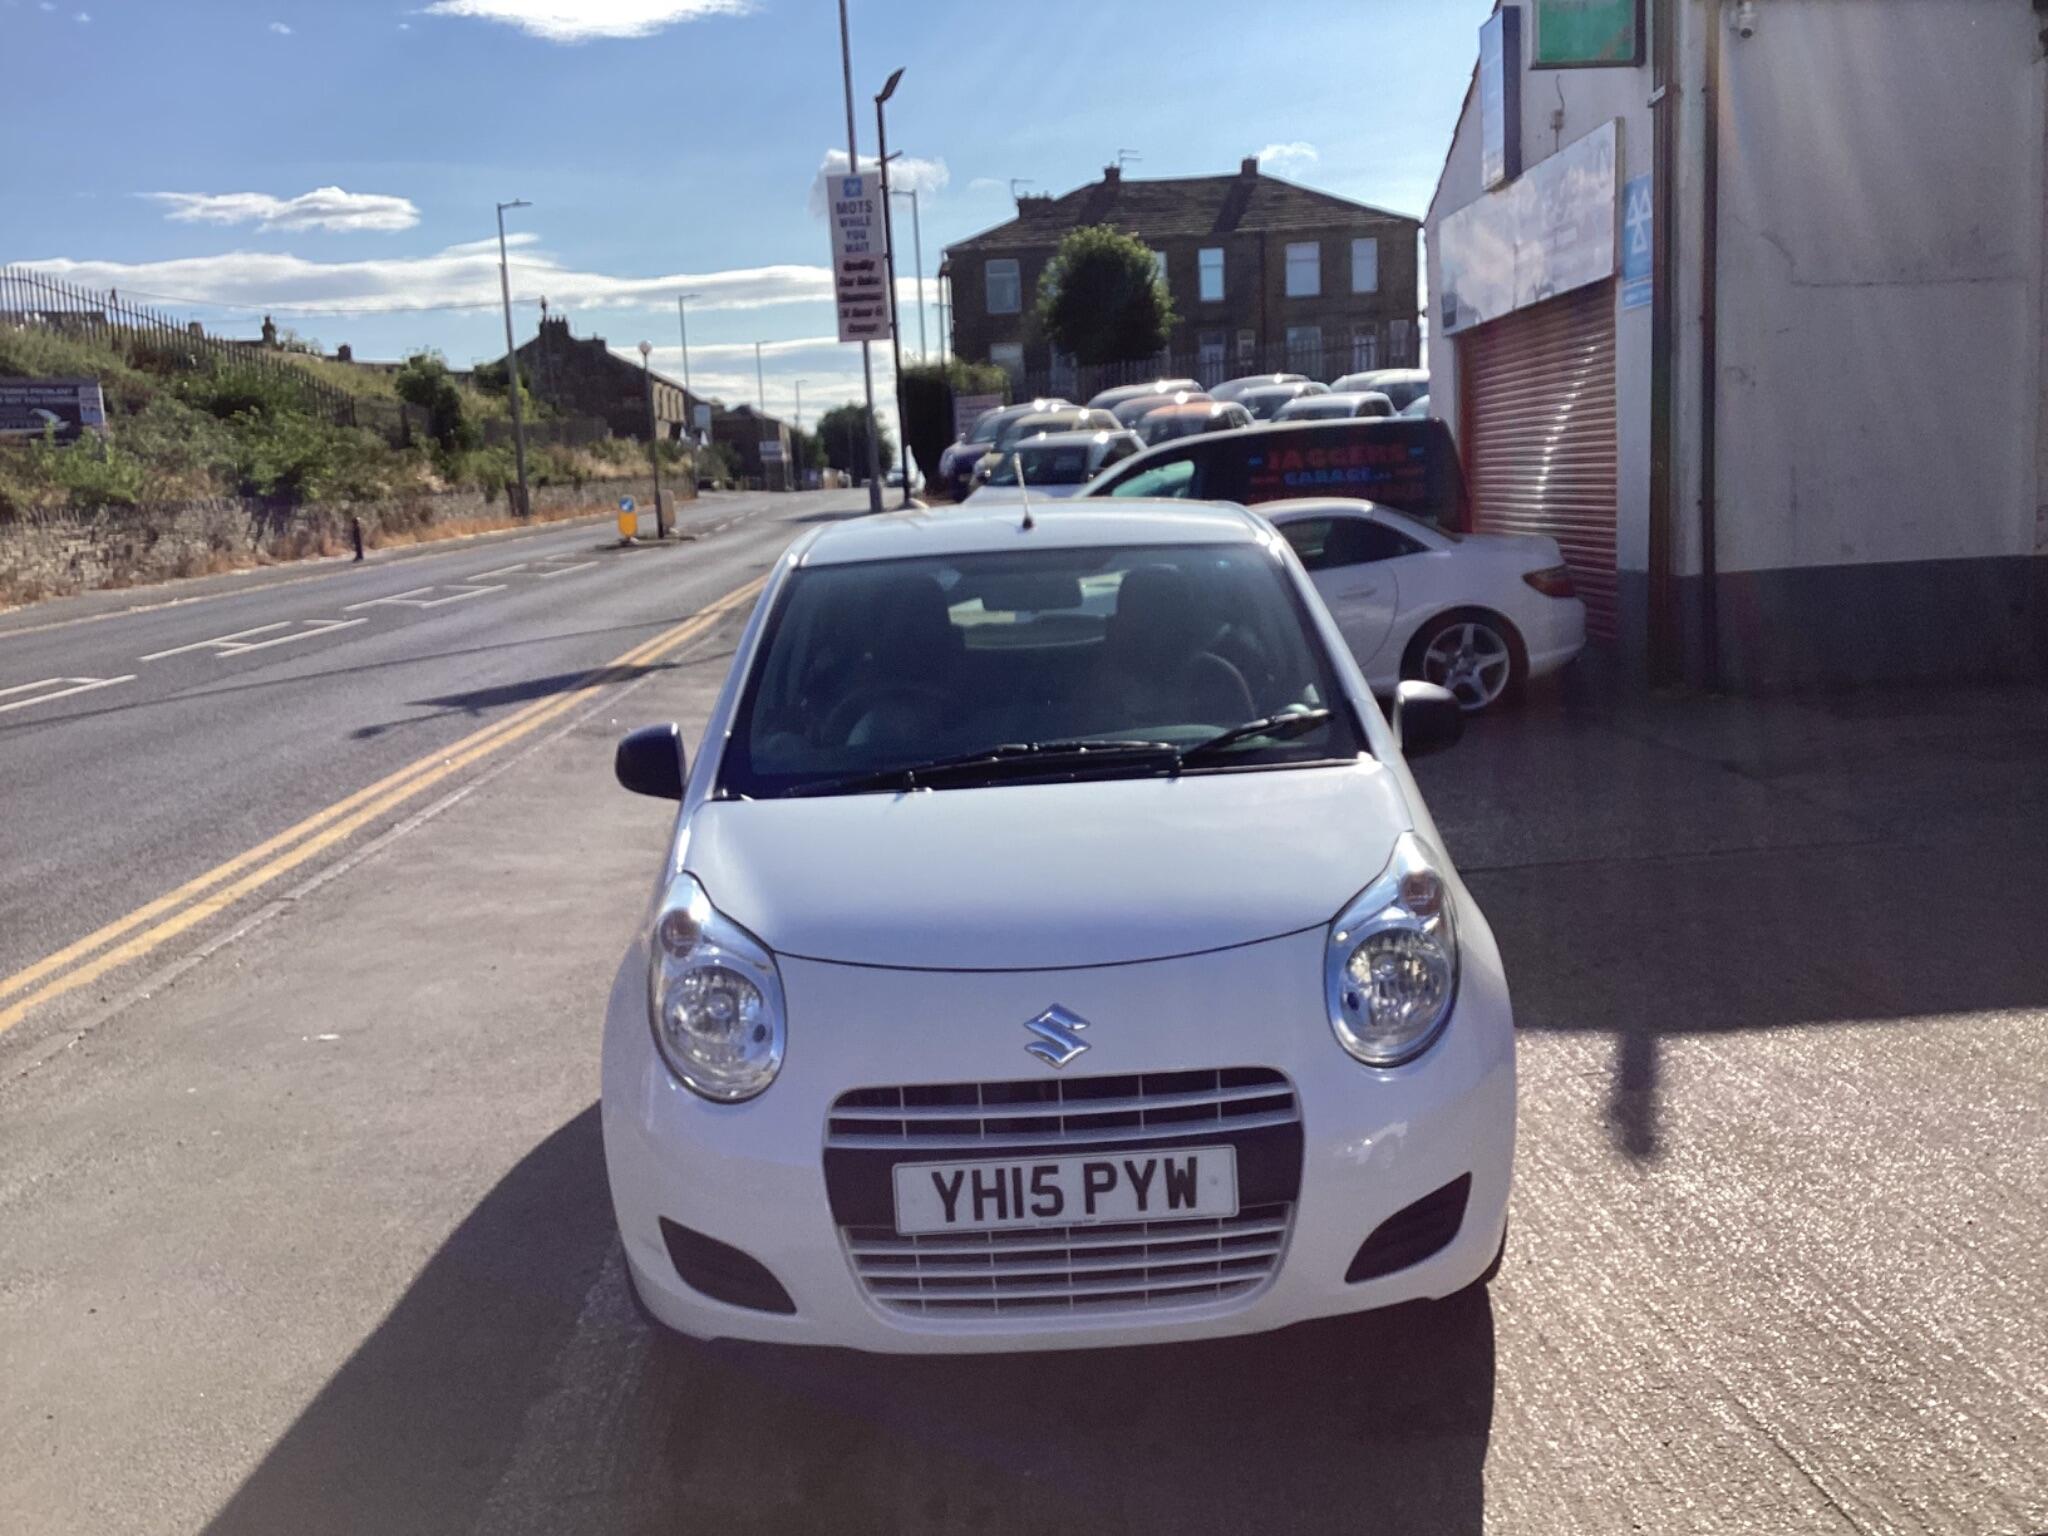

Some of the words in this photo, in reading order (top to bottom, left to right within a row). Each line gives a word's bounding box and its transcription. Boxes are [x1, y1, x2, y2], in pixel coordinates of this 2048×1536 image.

[836, 200, 873, 214] MOTS
[839, 215, 872, 228] WHILE
[846, 229, 867, 240] YOU
[844, 241, 870, 253] WAIT
[931, 1165, 1064, 1223] YH15
[1083, 1156, 1198, 1215] PYW
